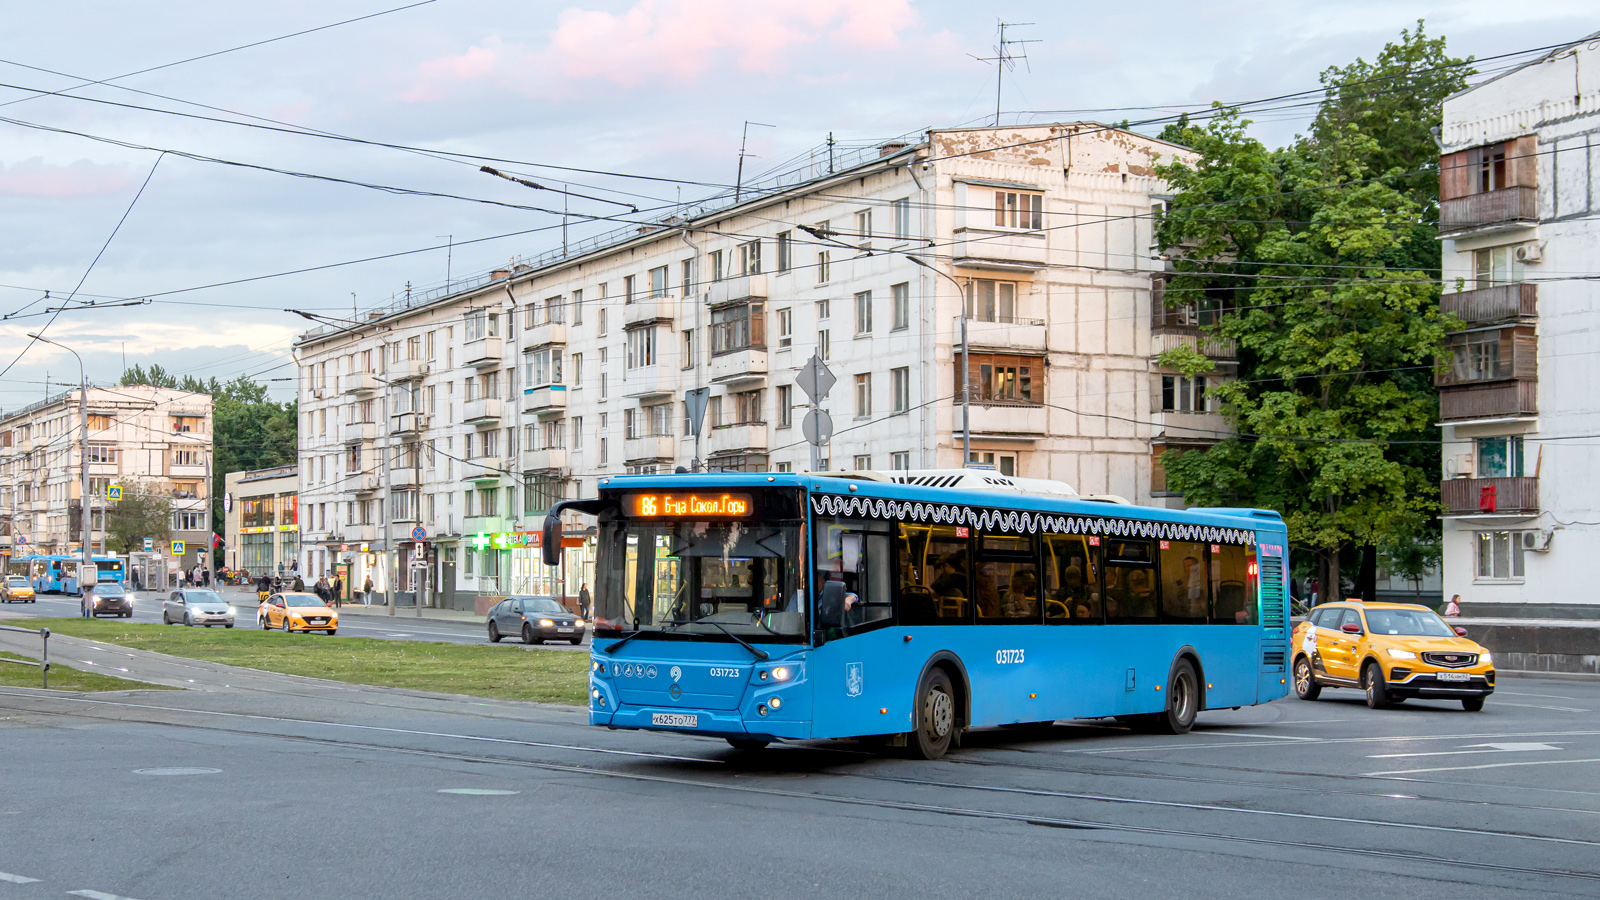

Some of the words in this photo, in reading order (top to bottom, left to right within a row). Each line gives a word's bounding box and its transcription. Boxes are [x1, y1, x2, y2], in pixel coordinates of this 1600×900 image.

[642, 497, 656, 515] 86
[665, 497, 686, 515] Б-ца
[995, 649, 1025, 664] 031723
[710, 667, 740, 678] 031723
